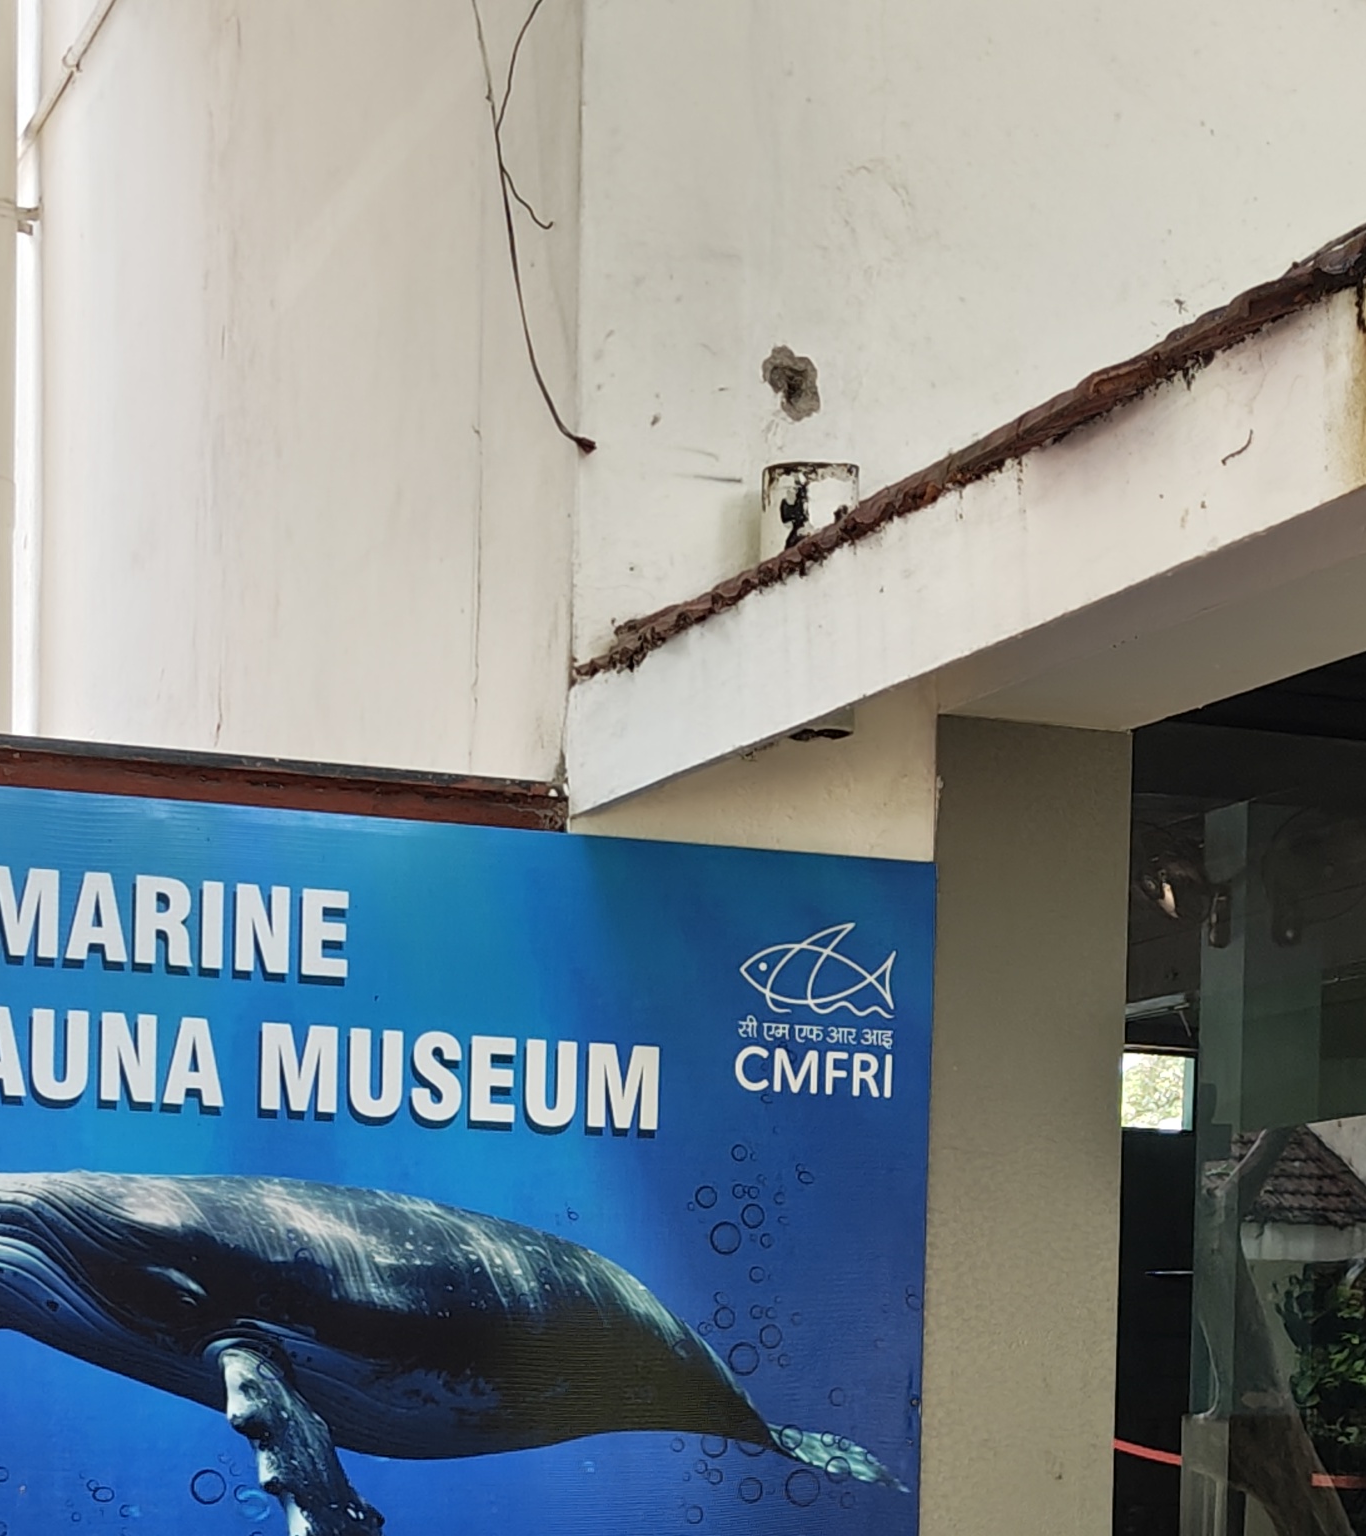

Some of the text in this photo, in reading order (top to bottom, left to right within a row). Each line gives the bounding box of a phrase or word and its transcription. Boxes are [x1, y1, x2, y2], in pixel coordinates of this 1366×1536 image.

[737, 1015, 758, 1038] सी
[762, 1022, 790, 1041] एम
[794, 1024, 824, 1043] एफ
[826, 1026, 857, 1045] आर
[260, 1022, 660, 1132] MUSEUM
[735, 1045, 893, 1098] CMFRI
